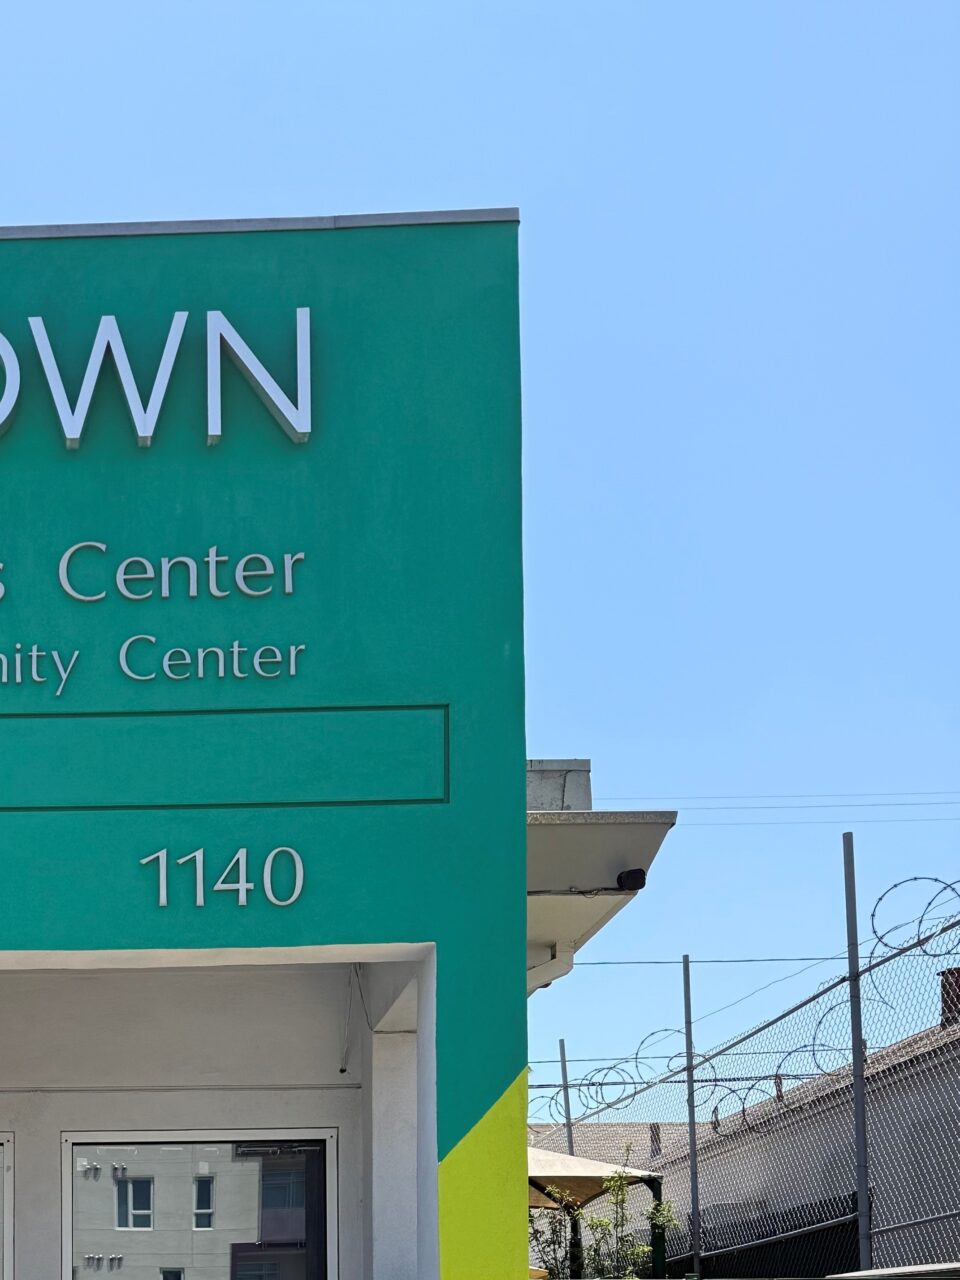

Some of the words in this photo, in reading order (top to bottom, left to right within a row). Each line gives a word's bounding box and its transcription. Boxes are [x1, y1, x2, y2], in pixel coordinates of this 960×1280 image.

[58, 540, 305, 602] Center
[119, 634, 306, 681] Center
[139, 846, 305, 907] 1140
